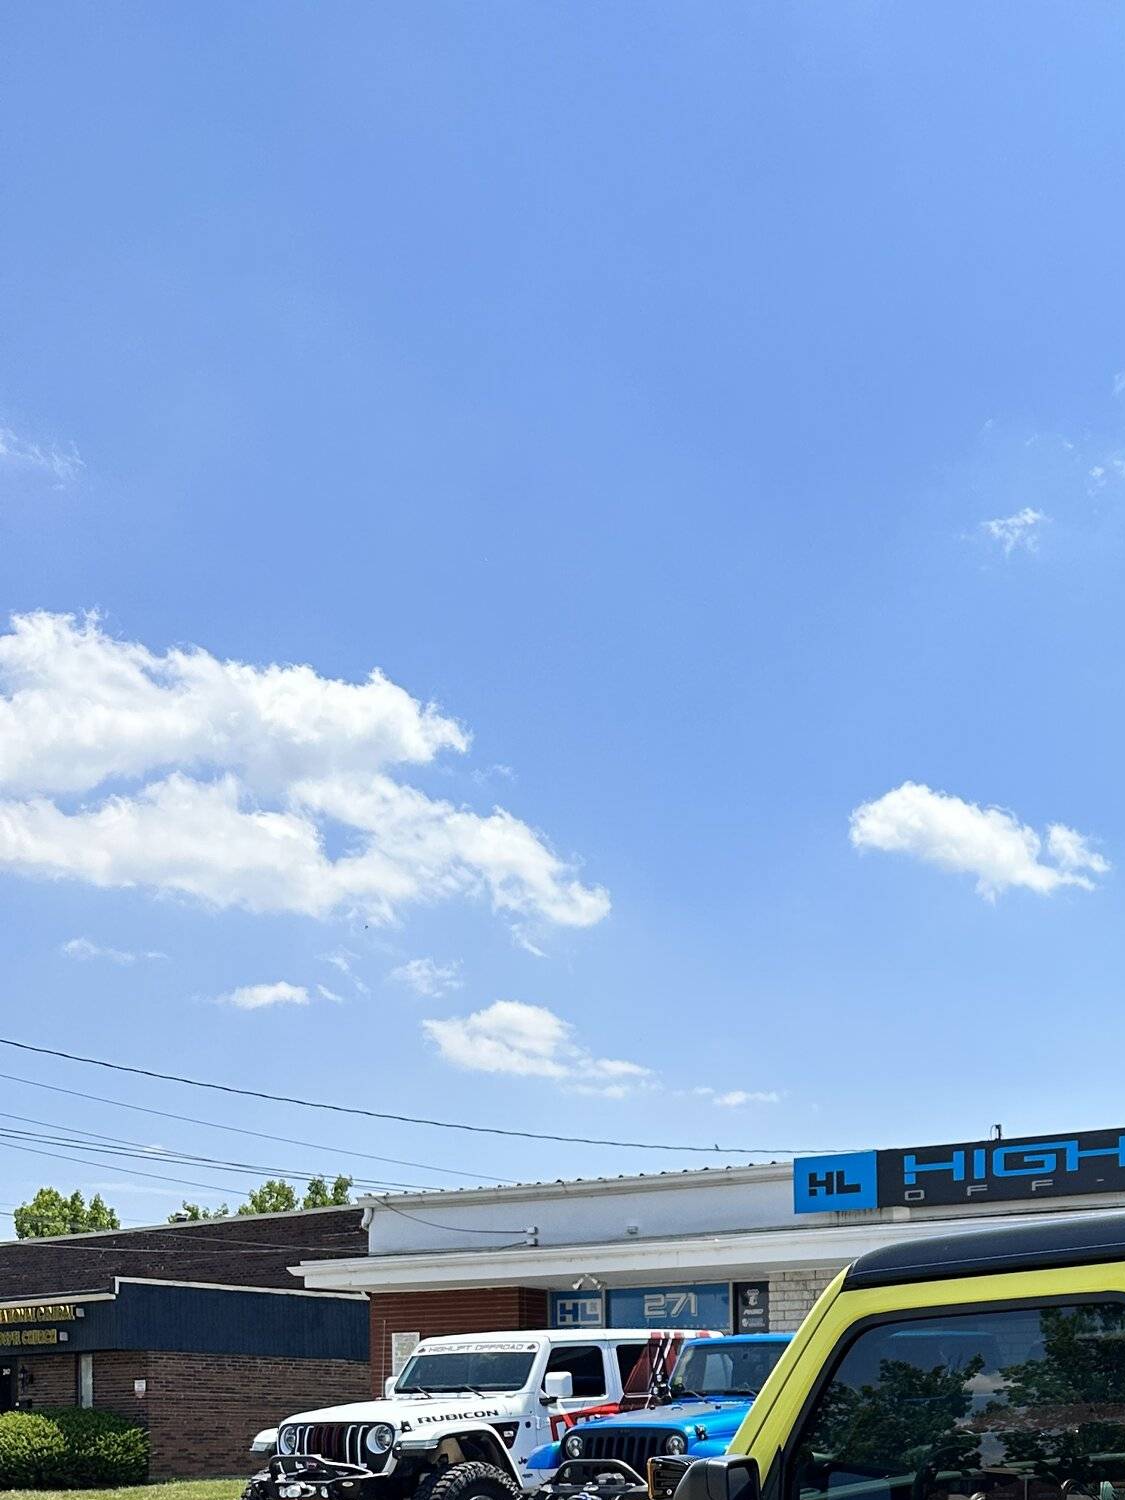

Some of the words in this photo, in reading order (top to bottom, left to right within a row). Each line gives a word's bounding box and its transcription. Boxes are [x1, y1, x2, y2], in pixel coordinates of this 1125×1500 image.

[808, 1170, 862, 1197] HL
[643, 1293, 698, 1319] 271
[417, 1409, 499, 1424] RUBICON
